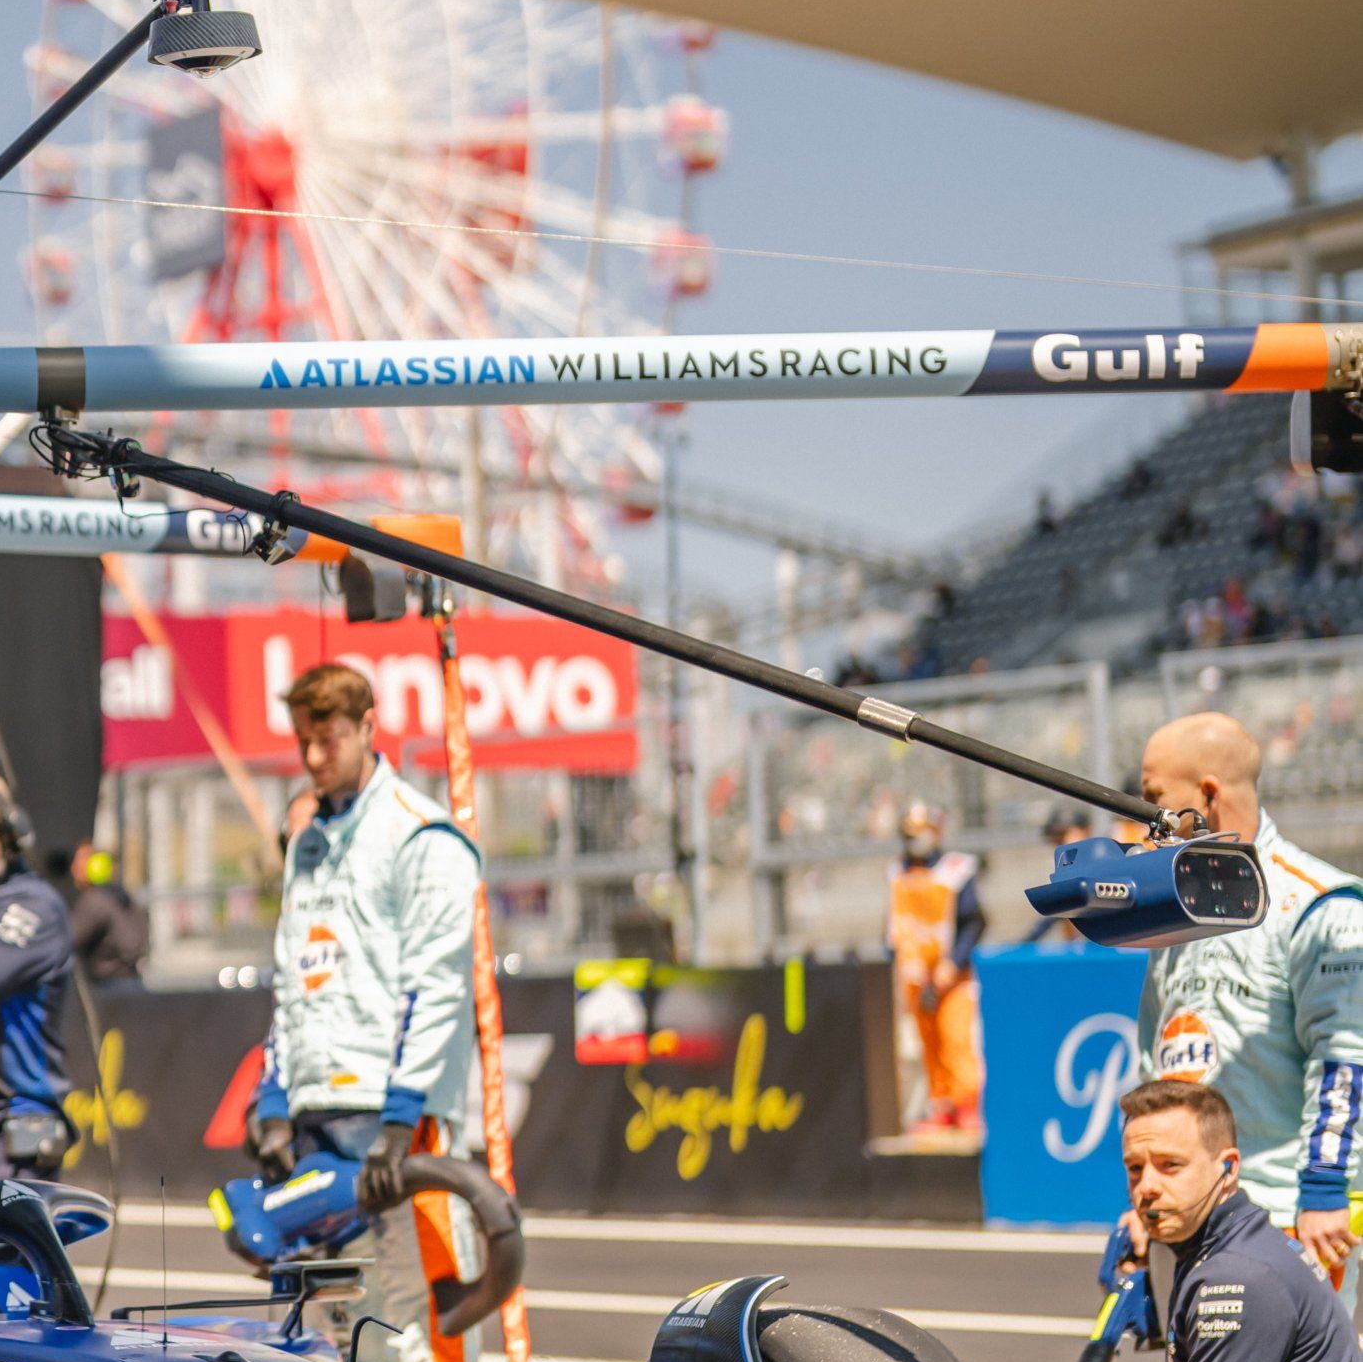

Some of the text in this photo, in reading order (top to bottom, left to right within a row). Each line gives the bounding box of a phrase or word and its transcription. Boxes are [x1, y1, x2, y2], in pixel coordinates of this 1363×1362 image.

[1030, 332, 1206, 382] Gulf
[299, 354, 535, 388] ATLASSIAN
[1208, 1284, 1245, 1295] KEEPER
[667, 1315, 707, 1329] ATLASSIAN
